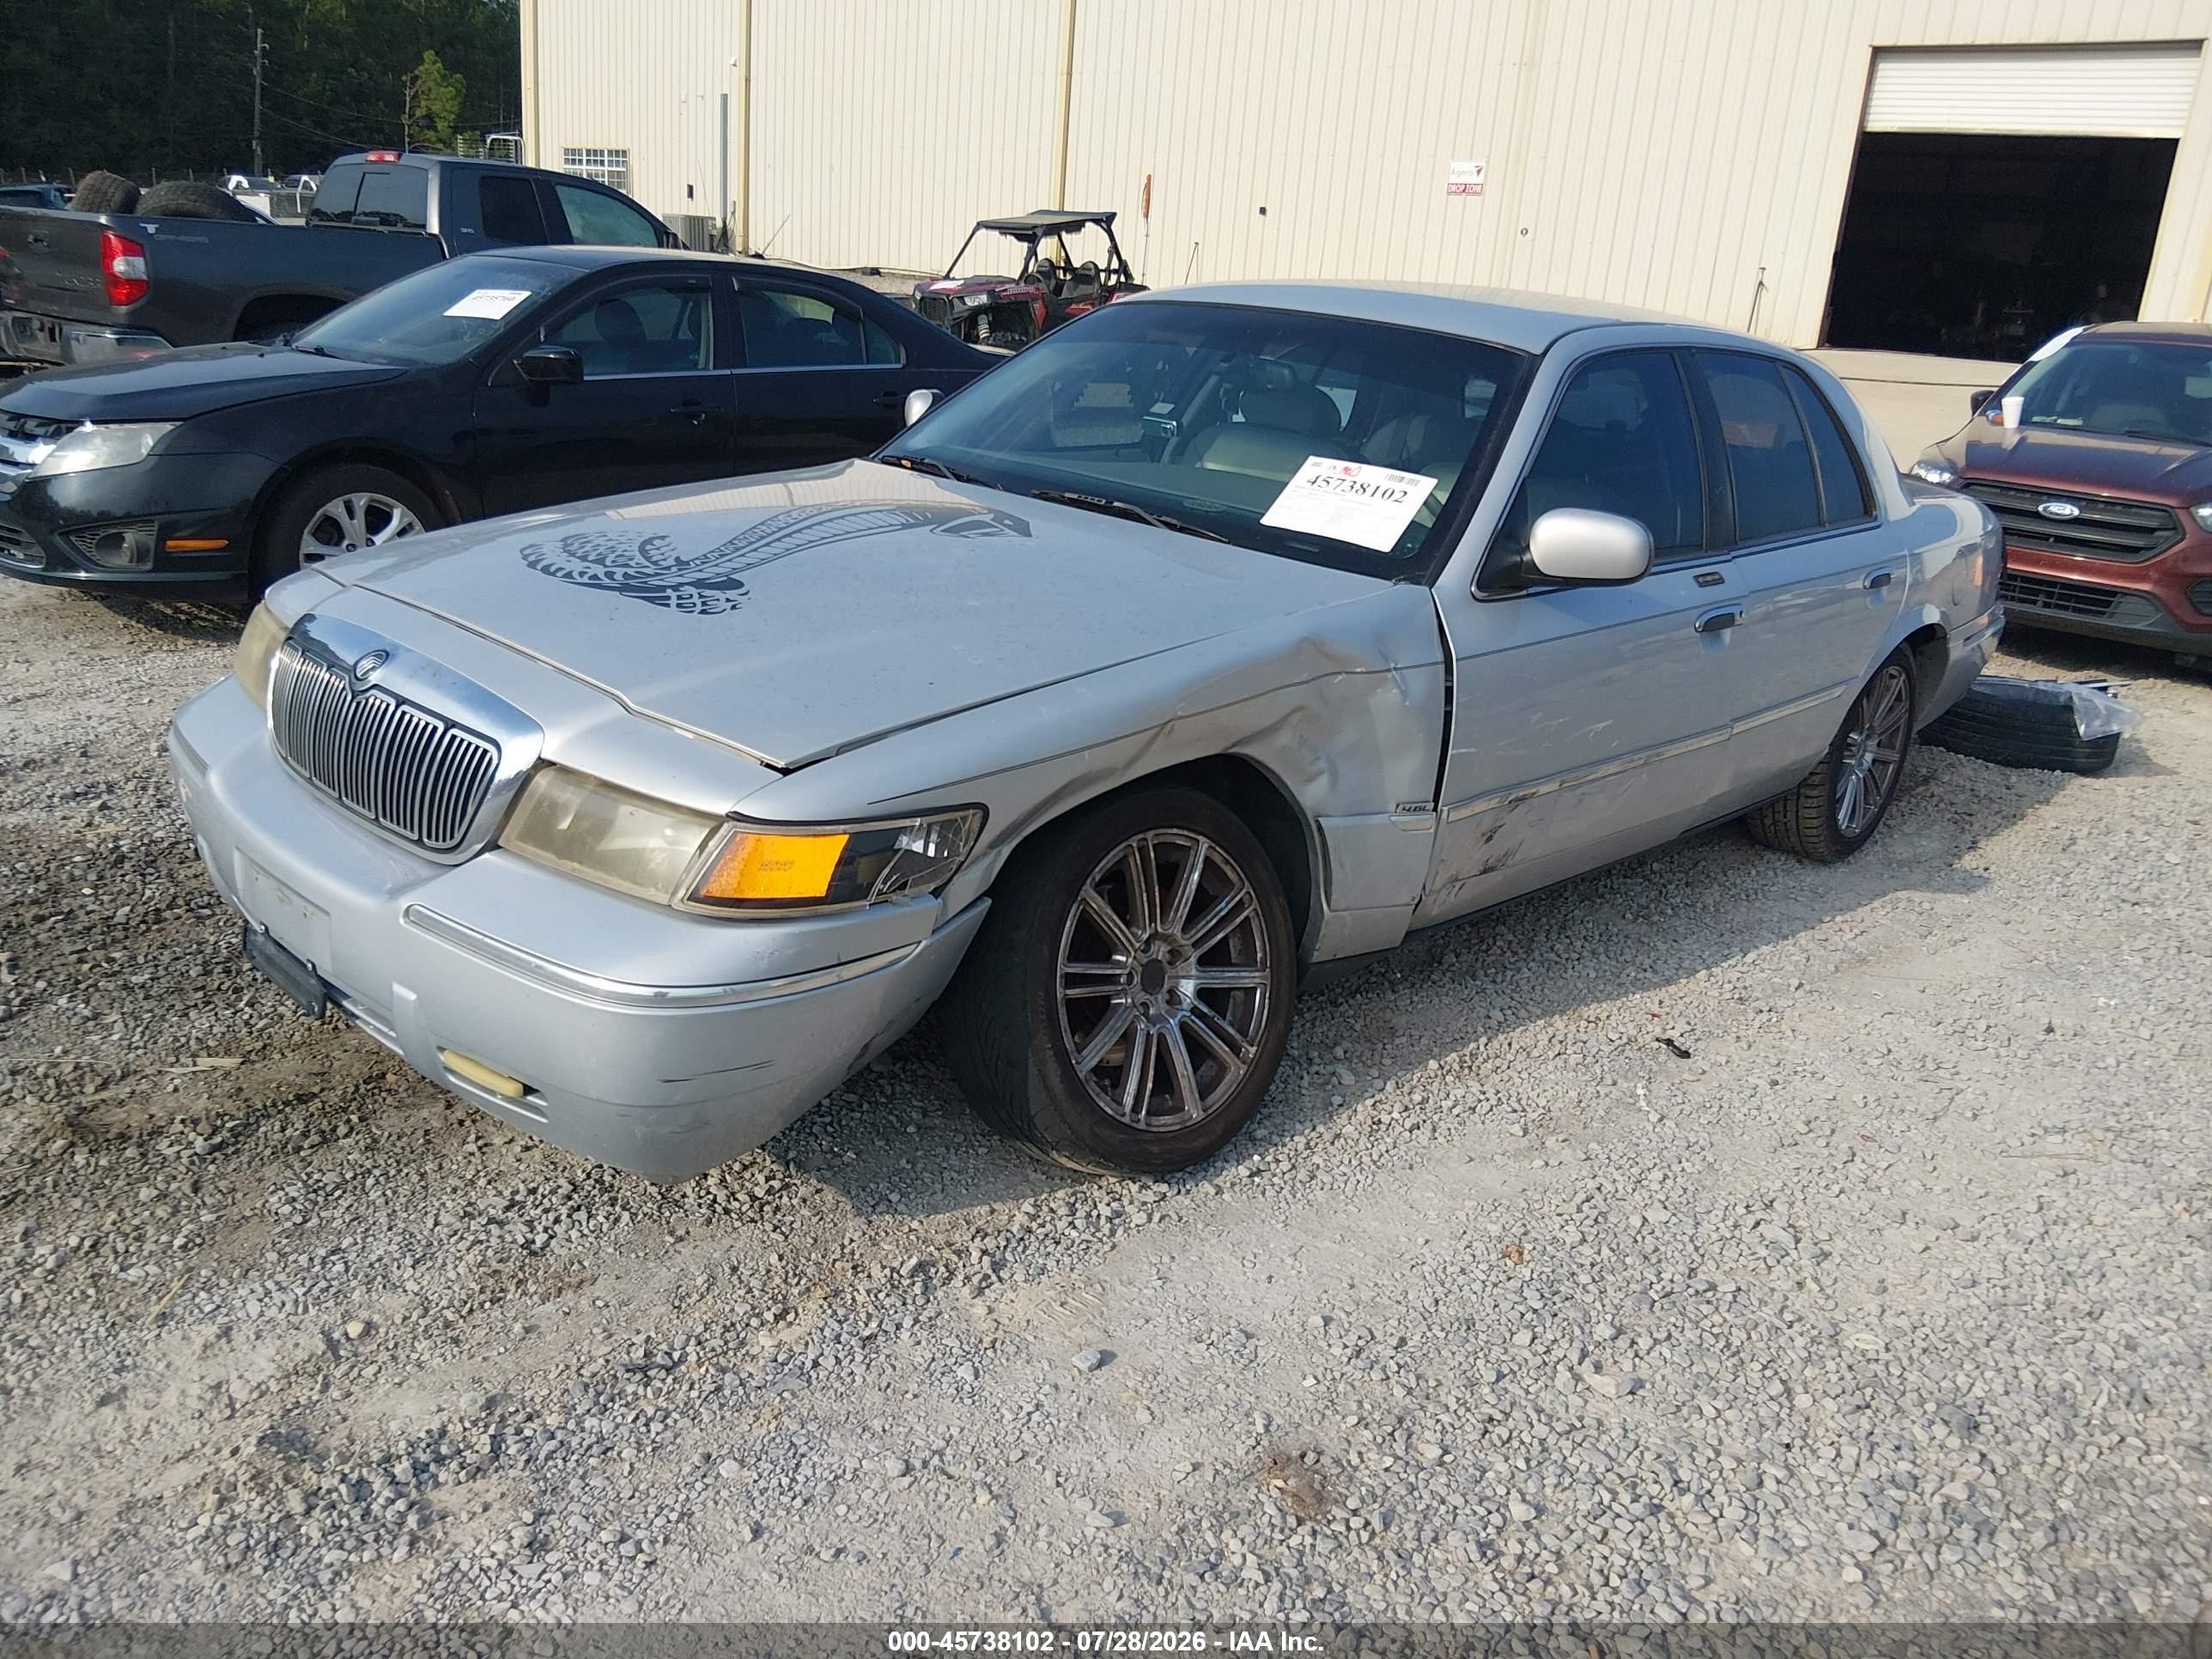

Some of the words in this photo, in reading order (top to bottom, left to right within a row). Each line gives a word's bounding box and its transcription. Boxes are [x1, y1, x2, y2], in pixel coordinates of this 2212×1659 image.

[1448, 184, 1465, 193] DROP
[1465, 184, 1482, 193] ZONE
[1306, 474, 1408, 503] 45738102
